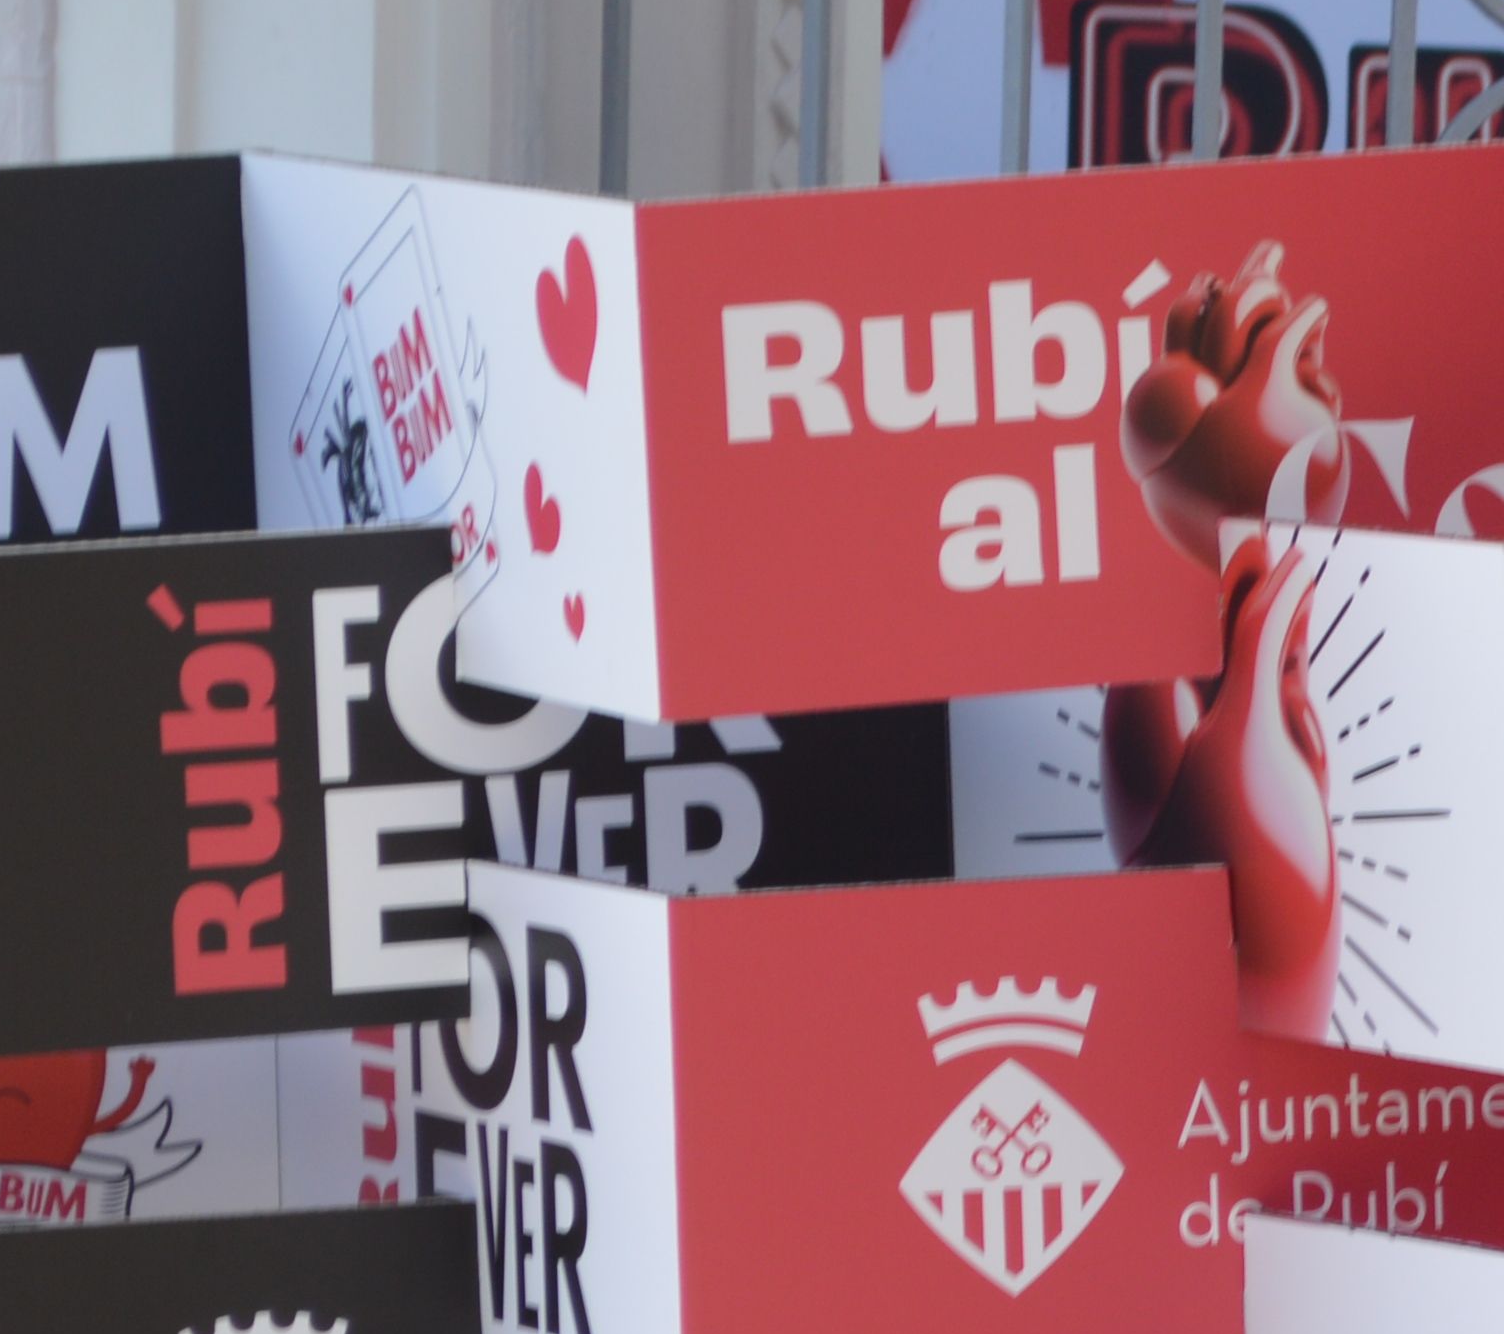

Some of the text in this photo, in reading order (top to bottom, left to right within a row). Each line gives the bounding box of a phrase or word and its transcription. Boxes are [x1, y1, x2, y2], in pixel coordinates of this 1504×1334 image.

[722, 258, 1172, 444] Rubí
[450, 501, 480, 566] OR
[938, 443, 1101, 593] al
[146, 584, 287, 996] Rubí
